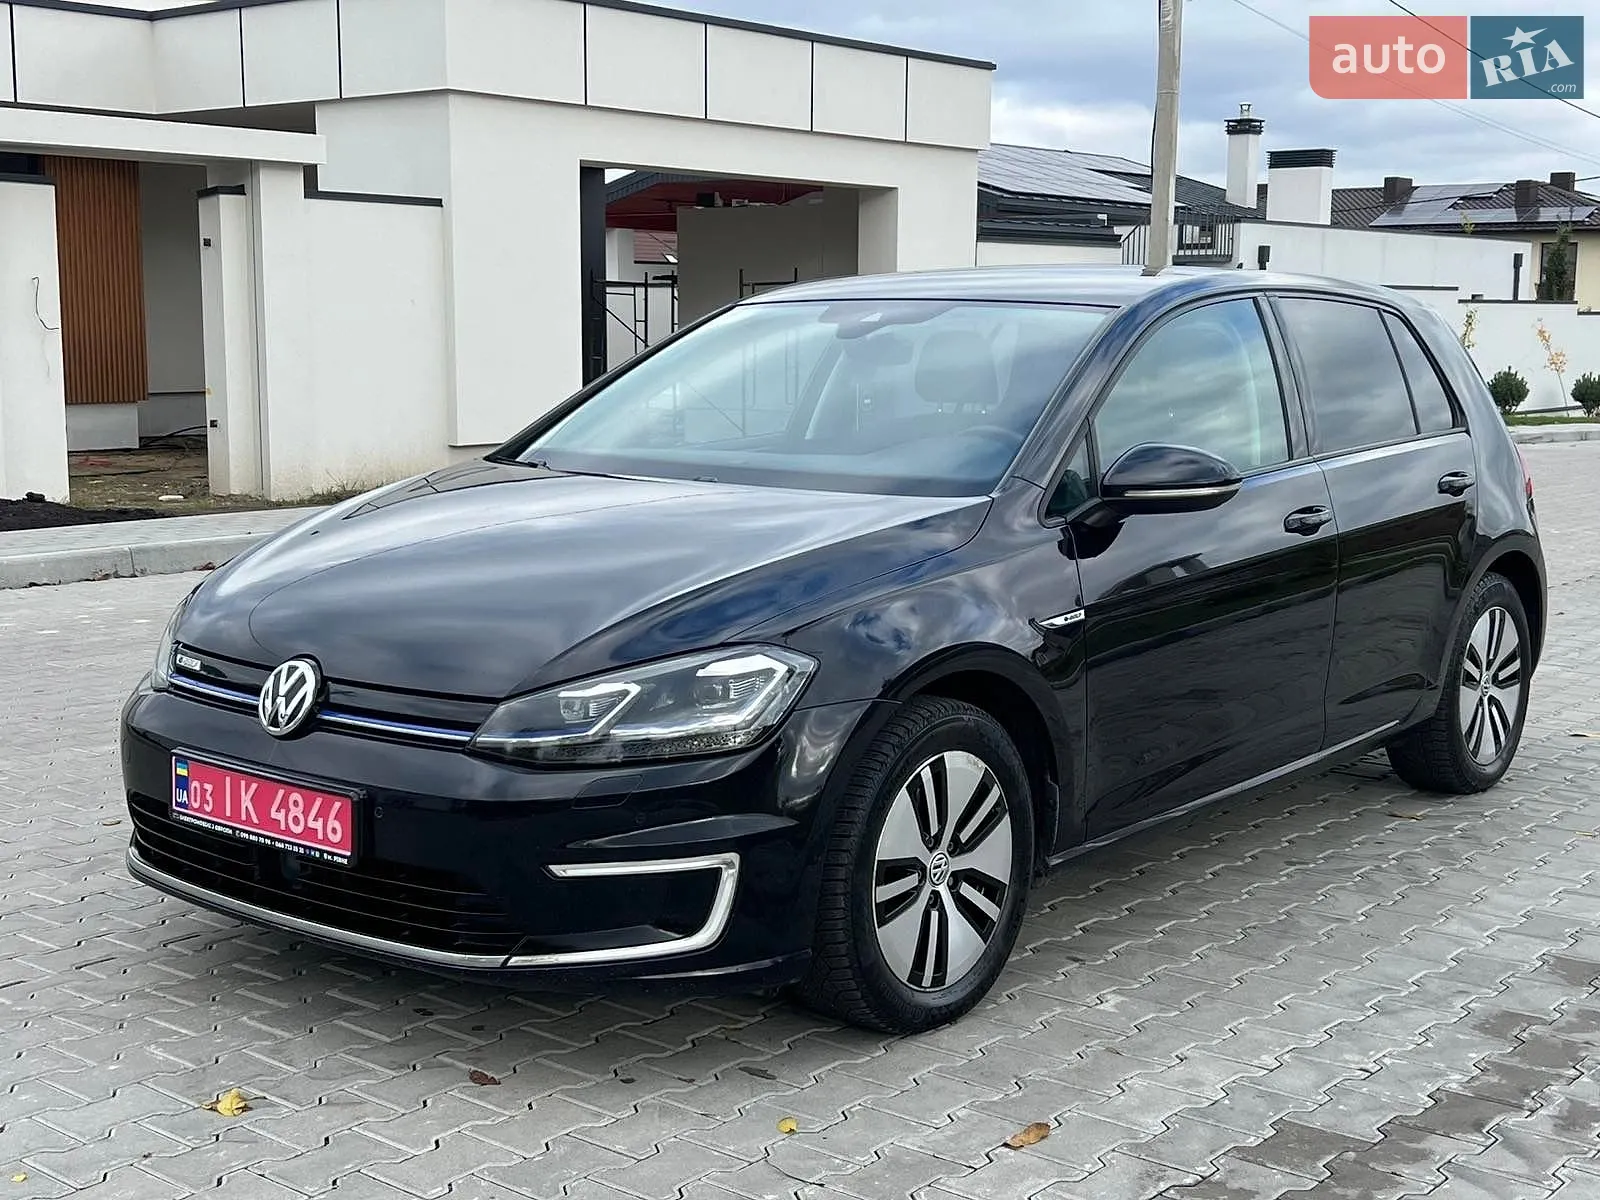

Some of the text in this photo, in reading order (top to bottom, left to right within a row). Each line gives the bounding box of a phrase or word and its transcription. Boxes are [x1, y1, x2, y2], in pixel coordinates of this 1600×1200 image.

[176, 788, 189, 804] UA
[190, 780, 214, 813] 03
[270, 788, 343, 844] 4846
